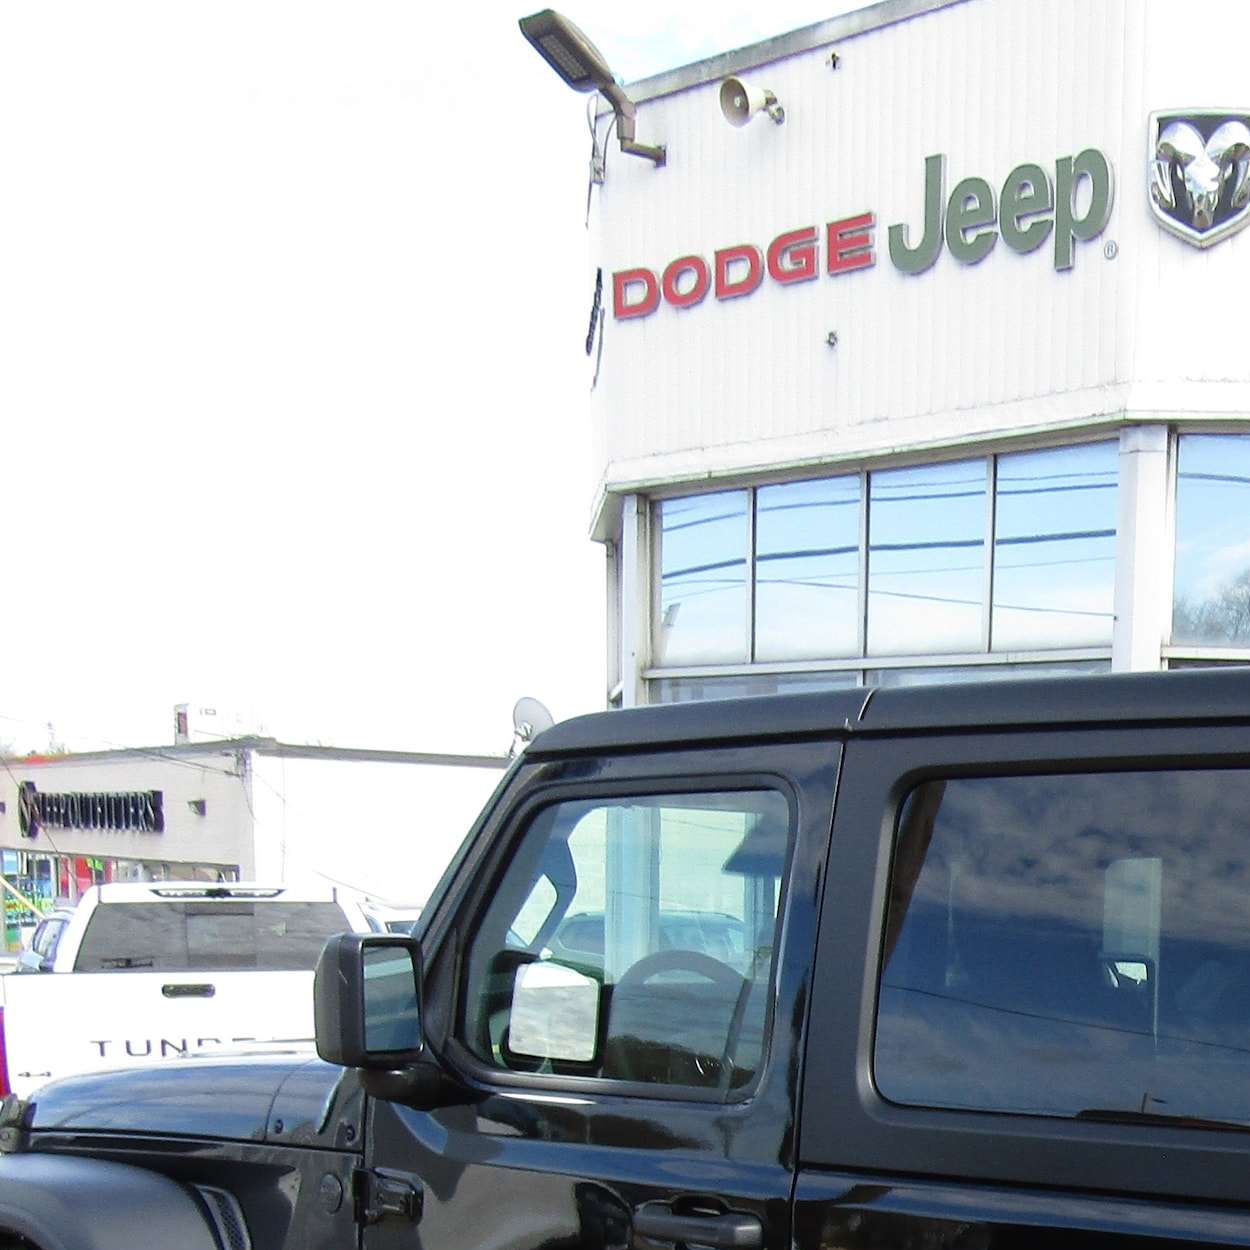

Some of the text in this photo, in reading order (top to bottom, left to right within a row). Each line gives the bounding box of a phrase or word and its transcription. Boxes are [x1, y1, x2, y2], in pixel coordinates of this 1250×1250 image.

[887, 147, 1115, 274] Jeep
[612, 212, 876, 321] DODGE
[90, 1037, 257, 1057] TUN
